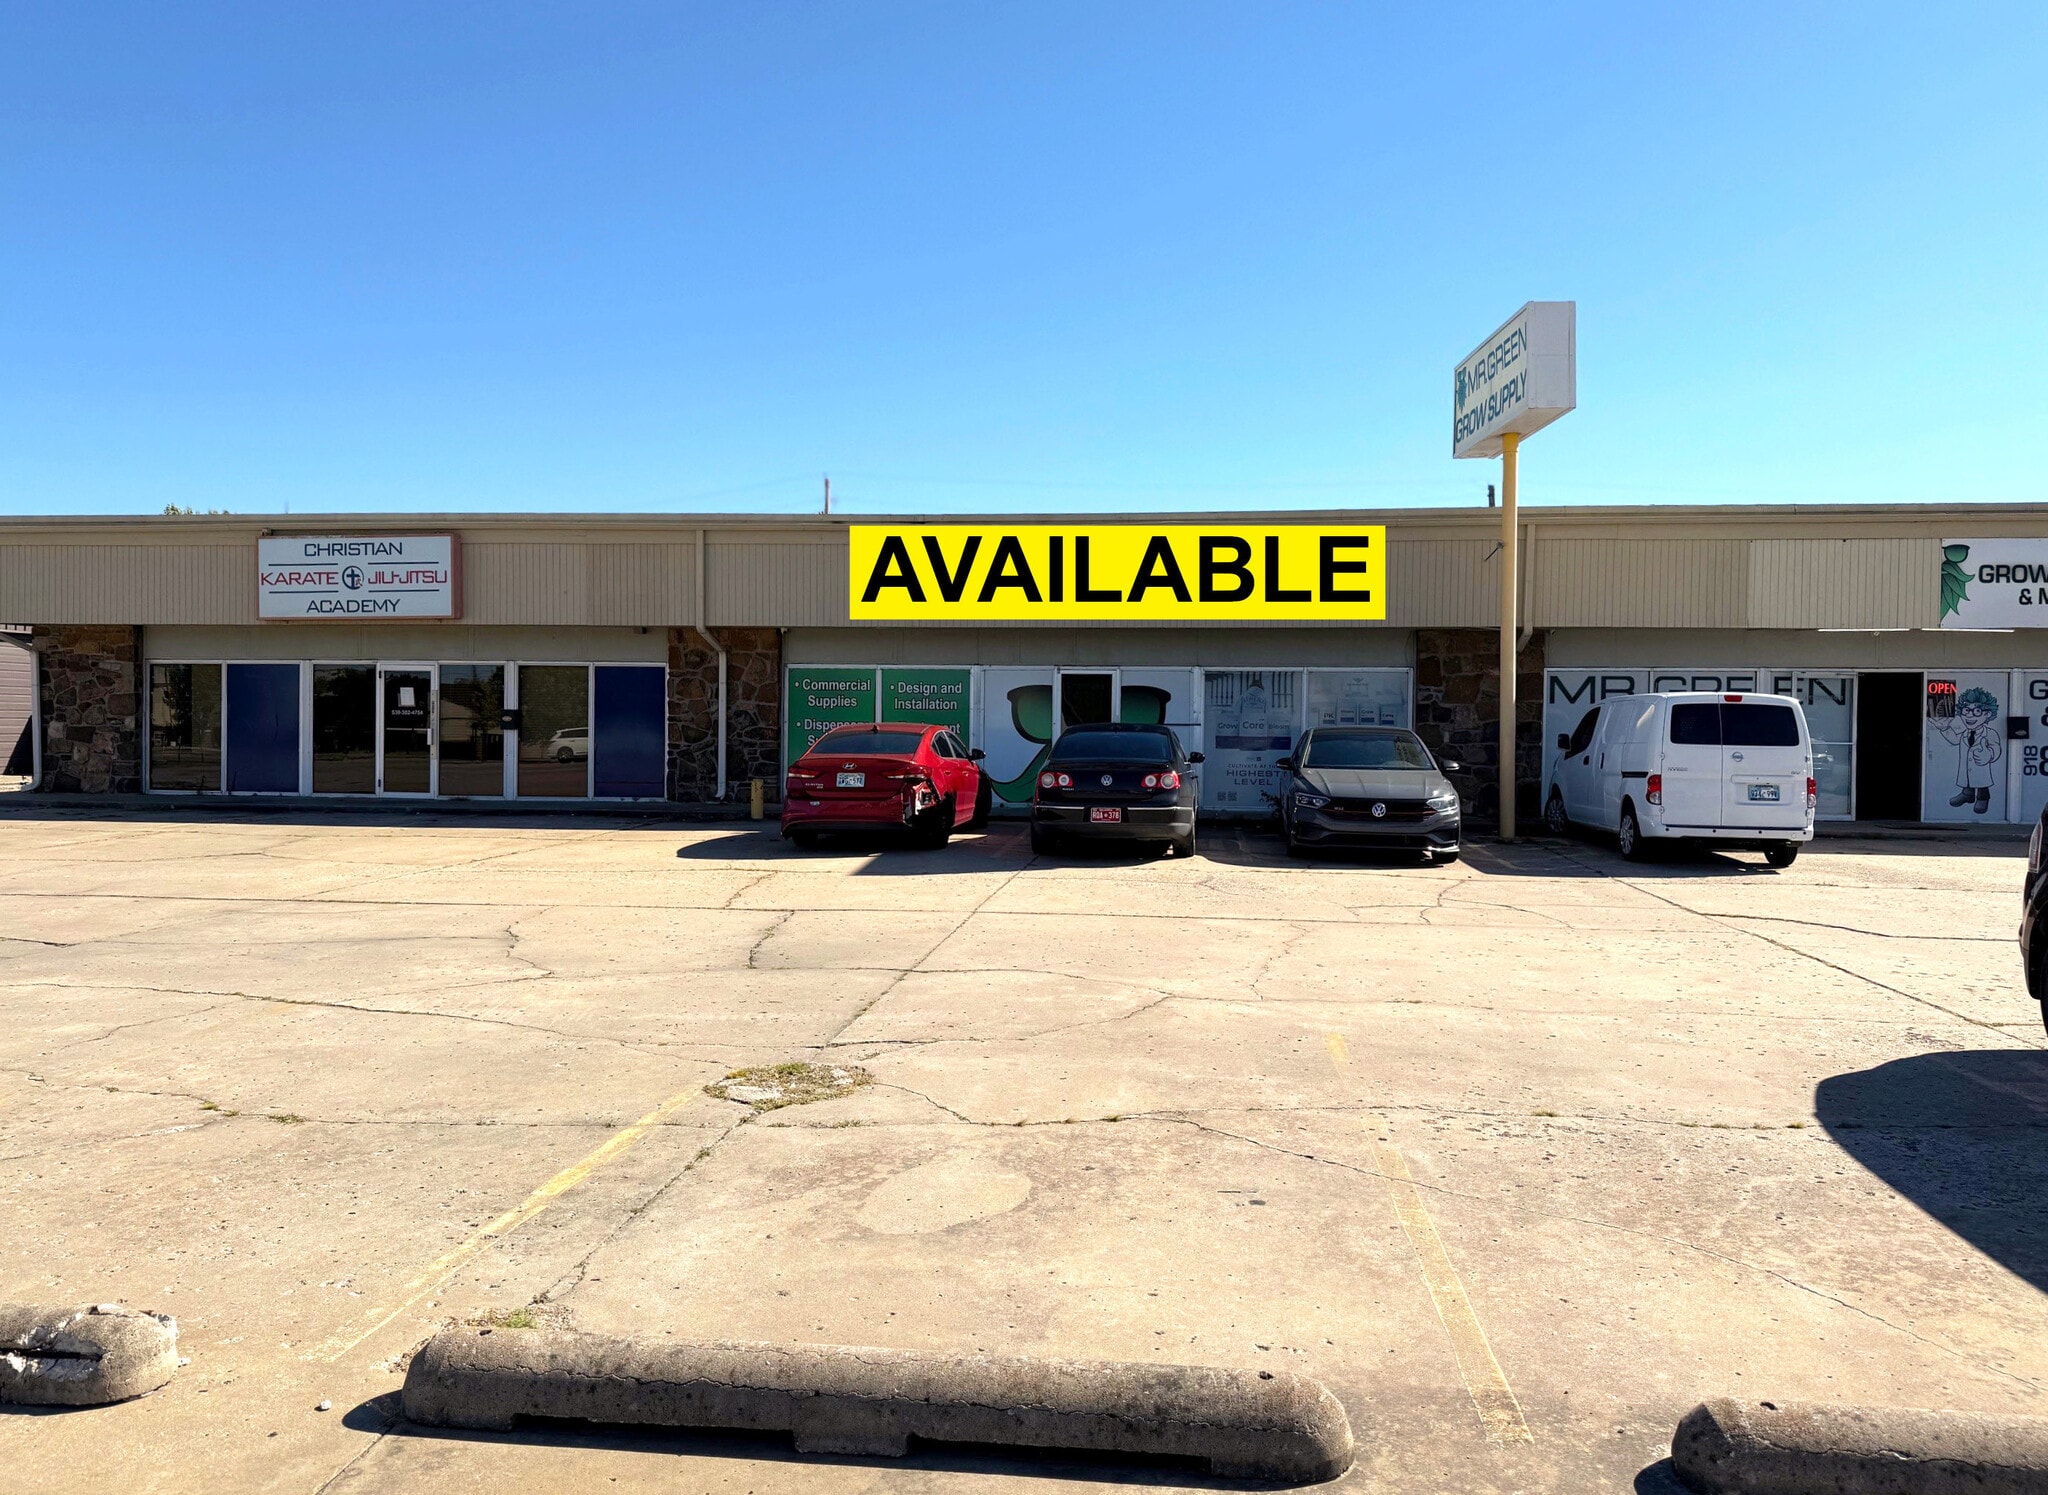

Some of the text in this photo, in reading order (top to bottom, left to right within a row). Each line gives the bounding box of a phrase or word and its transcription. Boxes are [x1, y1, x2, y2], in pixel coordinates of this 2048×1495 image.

[1487, 321, 1527, 382] GREEN
[1455, 368, 1528, 443] GROW SUPPLY
[304, 541, 403, 557] CHRISTIAN
[260, 571, 339, 586] KARATE
[367, 570, 448, 585] JIU-JITSU
[2019, 588, 2032, 605] &
[306, 598, 401, 614] ACADEMY
[802, 679, 871, 691] Commercial
[898, 682, 962, 695] Design and
[1928, 682, 1958, 694] OPEN
[807, 695, 858, 709] Supplies
[894, 698, 958, 710] Installation
[1242, 721, 1265, 730] Core
[2023, 745, 2038, 776] 918
[1226, 769, 1281, 777] HIGHEST
[1234, 778, 1273, 786] LEVEL
